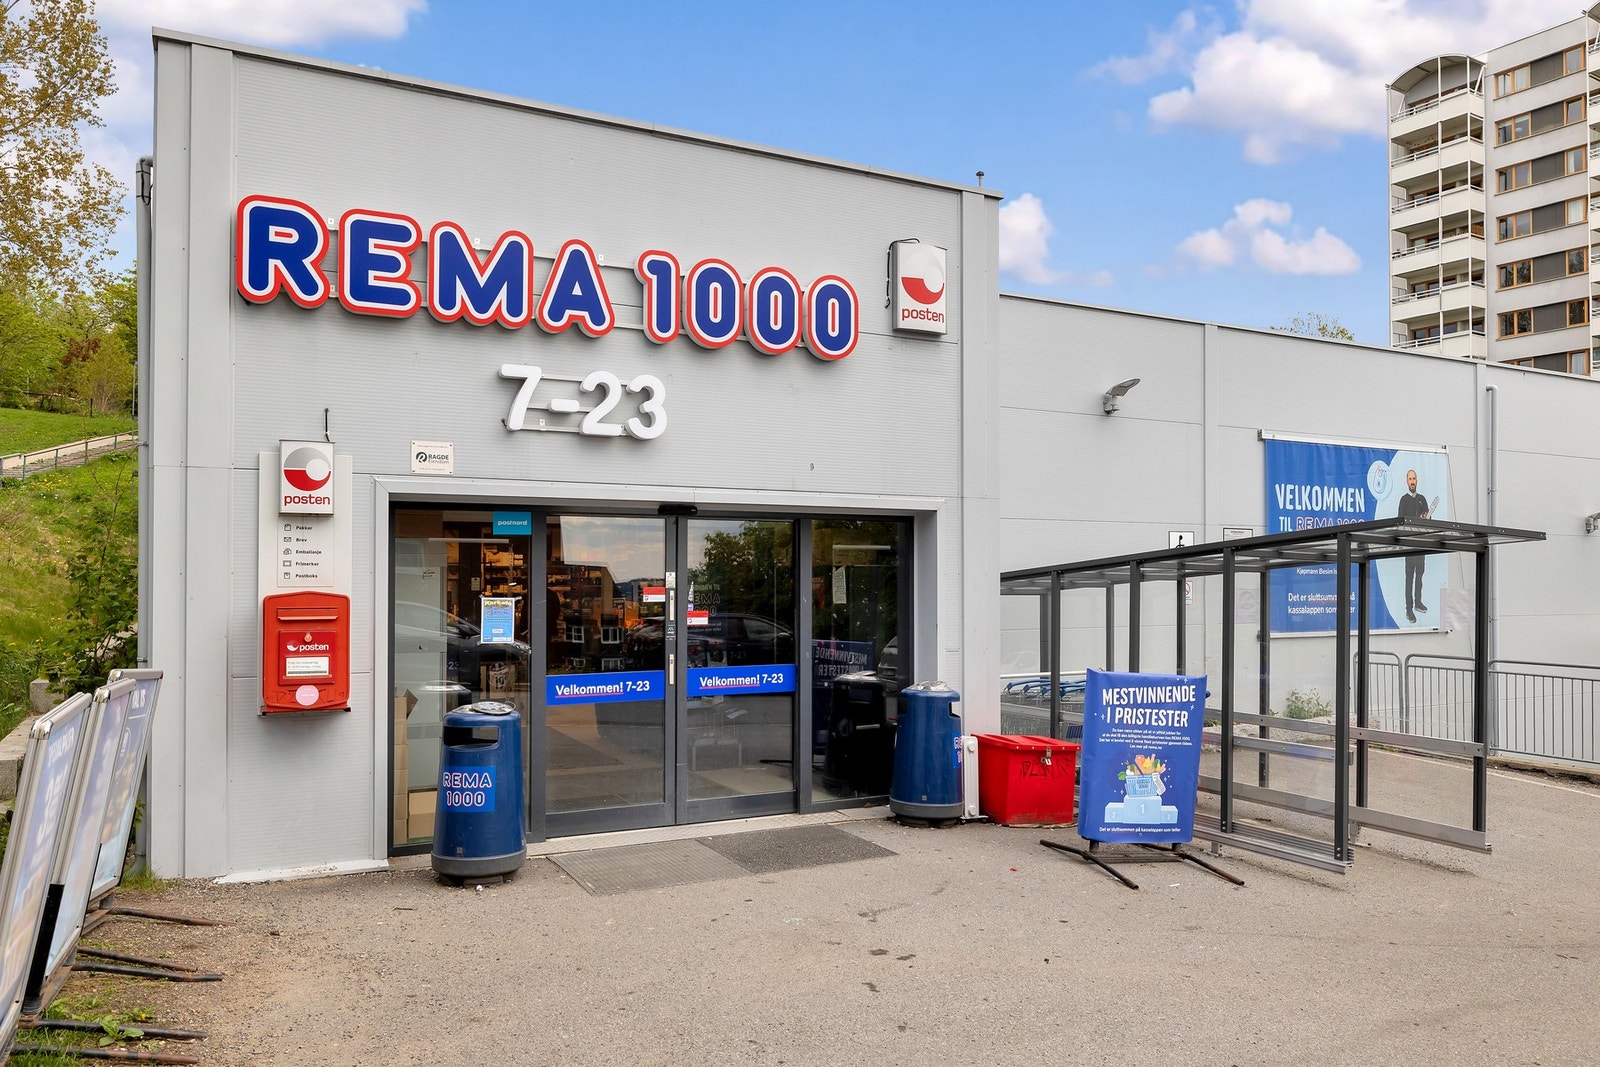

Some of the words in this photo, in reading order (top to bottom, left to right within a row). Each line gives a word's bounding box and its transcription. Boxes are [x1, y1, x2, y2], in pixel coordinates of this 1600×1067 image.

[237, 195, 615, 338] REMA
[635, 249, 860, 361] 1000
[902, 308, 945, 323] posten
[499, 364, 668, 440] 7-23
[284, 494, 330, 506] posten
[1274, 483, 1366, 513] VELKOMMEN
[1278, 516, 1293, 532] TIL
[1288, 592, 1300, 602] Det
[1288, 606, 1324, 615] kassalappen
[300, 643, 329, 652] posten
[700, 674, 760, 688] Velkommen!
[762, 673, 784, 684] 7-23
[556, 684, 624, 697] Velkommen!
[626, 681, 650, 692] 7-23
[1102, 685, 1196, 706] MESTVINNENDE
[1106, 706, 1111, 724] I
[1114, 708, 1188, 727] PRISTESTER
[443, 772, 492, 788] REMA
[446, 790, 485, 806] 1000
[1140, 803, 1145, 814] 1
